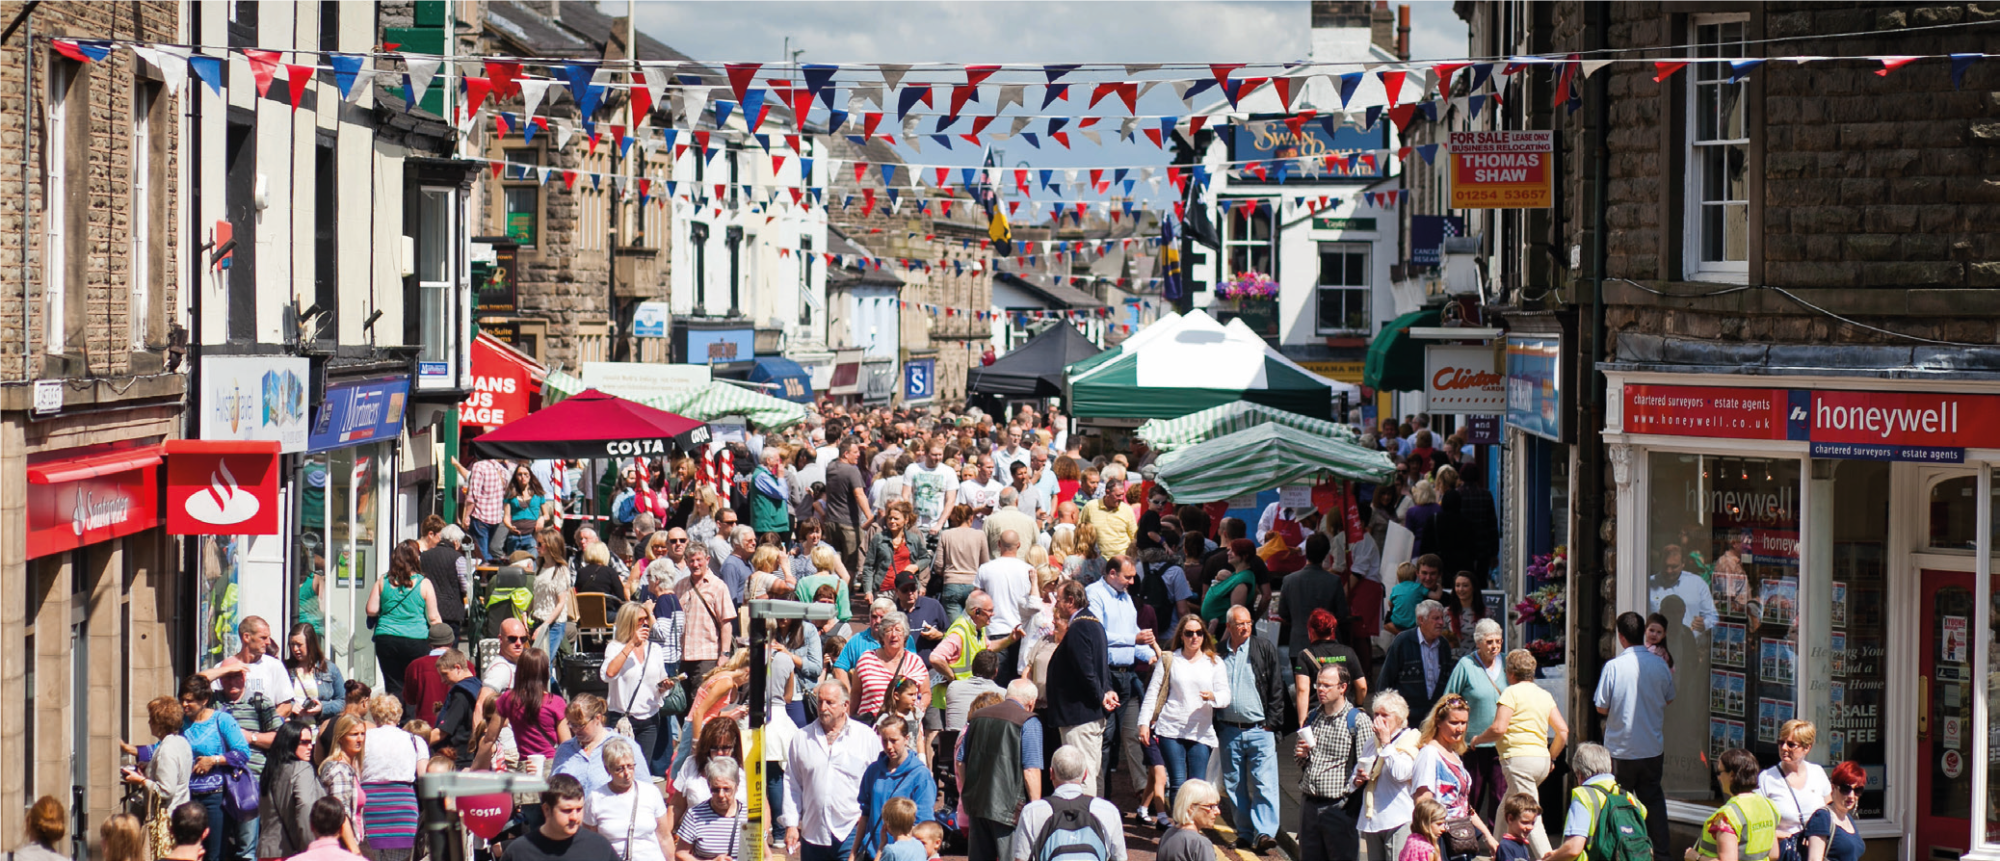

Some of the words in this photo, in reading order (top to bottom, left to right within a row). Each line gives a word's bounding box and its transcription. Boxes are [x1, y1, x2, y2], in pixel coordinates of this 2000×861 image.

[1254, 123, 1314, 150] SWAN
[1450, 132, 1475, 144] FOR
[1477, 132, 1510, 144] SALE
[1512, 133, 1533, 142] LEASE
[1533, 132, 1550, 141] ONLY
[1451, 144, 1495, 152] BUSINESS
[1496, 143, 1551, 151] RELOCATING
[1462, 153, 1540, 168] THOMAS
[1474, 168, 1527, 183] SHAW
[1455, 190, 1498, 200] 01254
[1504, 189, 1547, 200] 53657
[1348, 364, 1365, 372] NE
[1432, 366, 1503, 391] Clinton
[1633, 394, 1666, 406] chartered
[1668, 397, 1704, 409] surveyors
[1714, 398, 1739, 409] estate
[1742, 400, 1771, 411] agents
[1633, 413, 1770, 429] www.honeywell.co.uk
[1816, 397, 1958, 438] honeywell
[1475, 421, 1491, 429] and
[690, 425, 710, 444] COSTA
[1475, 431, 1491, 439] Ivy
[606, 439, 664, 456] COSTA
[1815, 445, 1851, 455] chartered
[1853, 447, 1891, 457] surveyors
[1902, 449, 1927, 458] estate
[1930, 451, 1958, 461] agents
[1685, 479, 1792, 523] honeywell
[86, 489, 129, 531] Santander
[1861, 645, 1884, 657] You
[1864, 664, 1872, 673] a
[245, 678, 265, 691] CURL
[1849, 680, 1884, 690] Home
[1842, 704, 1877, 717] SALE
[1846, 729, 1877, 743] FEE
[469, 807, 502, 817] COSTA
